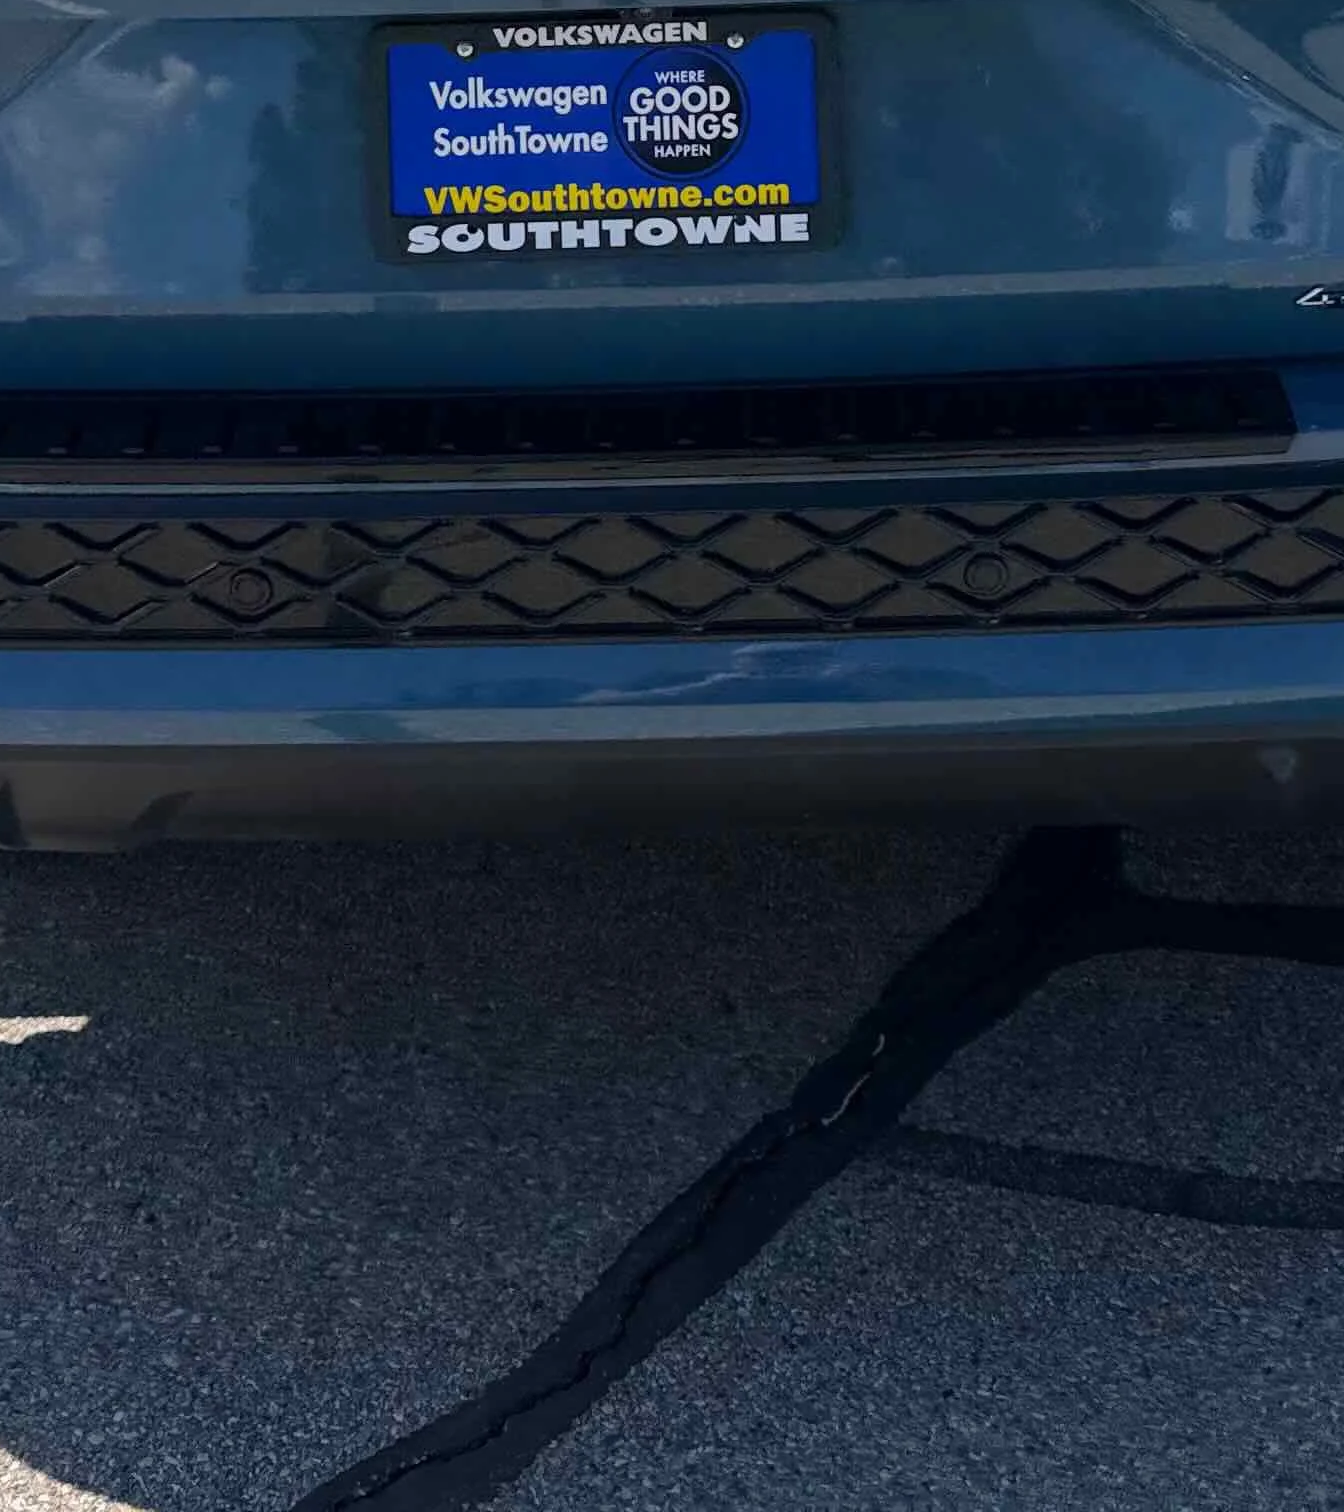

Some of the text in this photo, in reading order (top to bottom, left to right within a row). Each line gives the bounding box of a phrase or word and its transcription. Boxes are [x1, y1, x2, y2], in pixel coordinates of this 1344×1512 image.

[492, 20, 709, 49] VOLKSWAGEN
[654, 69, 706, 85] WHERE
[428, 77, 608, 114] Volkswagen
[629, 85, 731, 115] GOOD
[432, 124, 609, 158] SouthTowne
[622, 112, 740, 142] THINGS
[654, 144, 712, 158] HAPPEN
[423, 181, 790, 215] VWSouthtowne.com
[406, 212, 810, 254] SOUTHTOWNE
